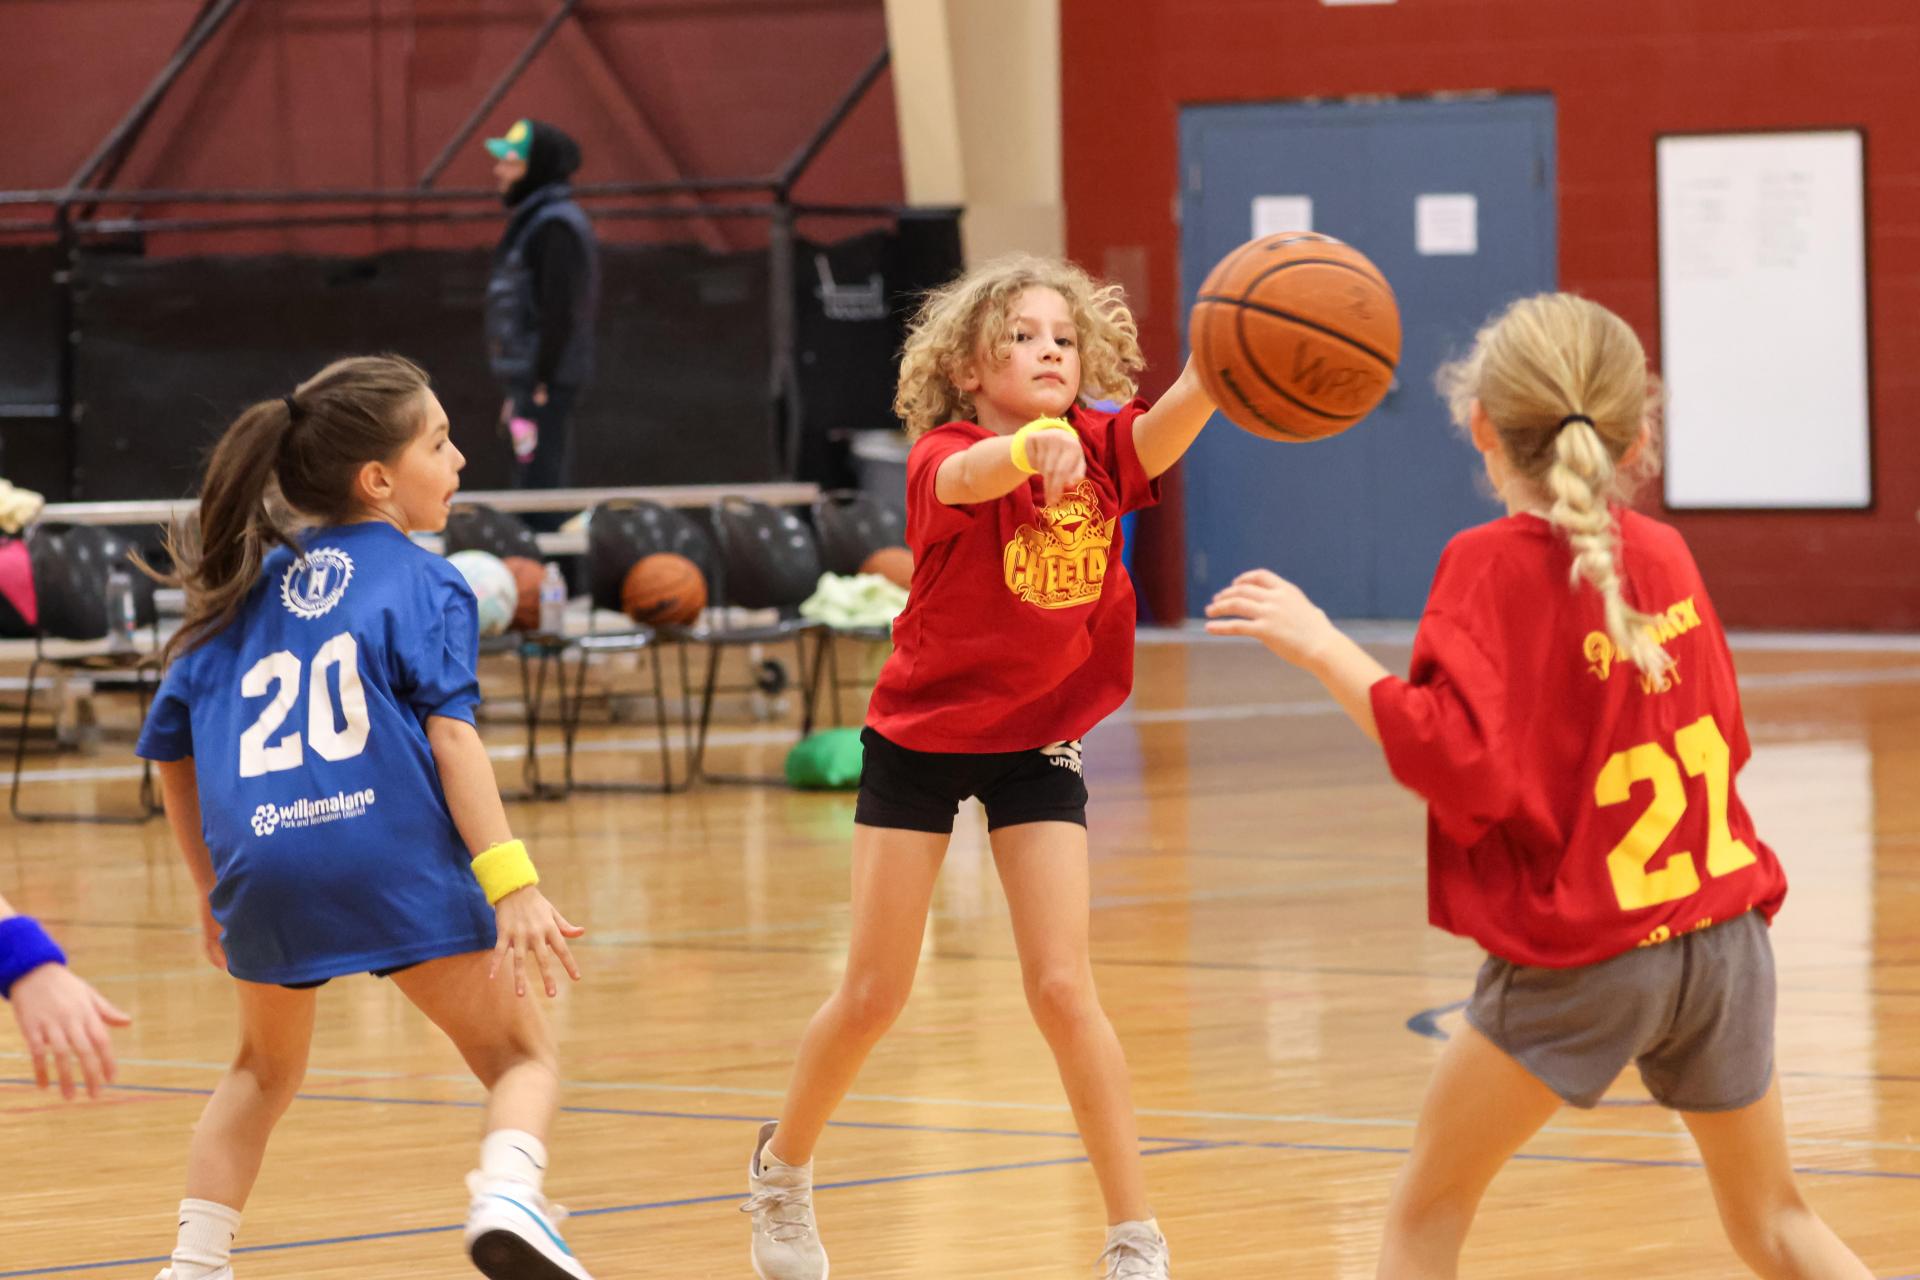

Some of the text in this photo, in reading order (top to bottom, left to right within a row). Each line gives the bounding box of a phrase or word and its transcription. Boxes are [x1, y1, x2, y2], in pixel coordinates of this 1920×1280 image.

[240, 632, 370, 778] 20
[279, 788, 376, 820] willamalane
[281, 807, 366, 828] Park and Recreation District
[1595, 715, 1757, 911] 21
